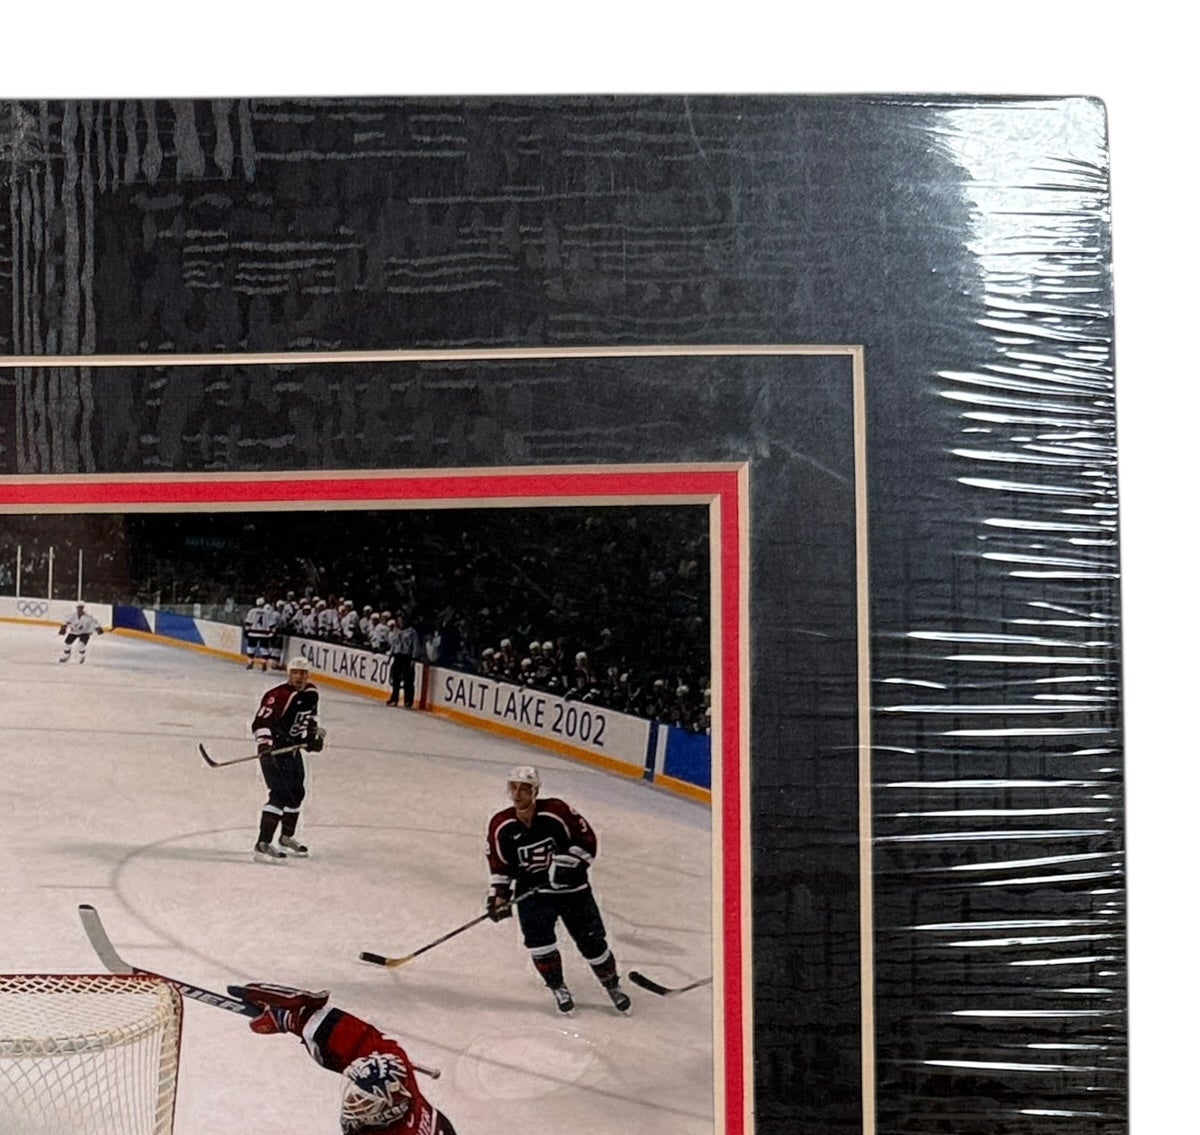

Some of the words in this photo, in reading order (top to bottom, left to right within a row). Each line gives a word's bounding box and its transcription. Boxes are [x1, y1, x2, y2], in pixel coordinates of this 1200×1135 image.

[332, 649, 367, 680] LAKE
[444, 676, 489, 711] SALT
[493, 687, 546, 728] LAKE
[551, 703, 606, 746] 2002
